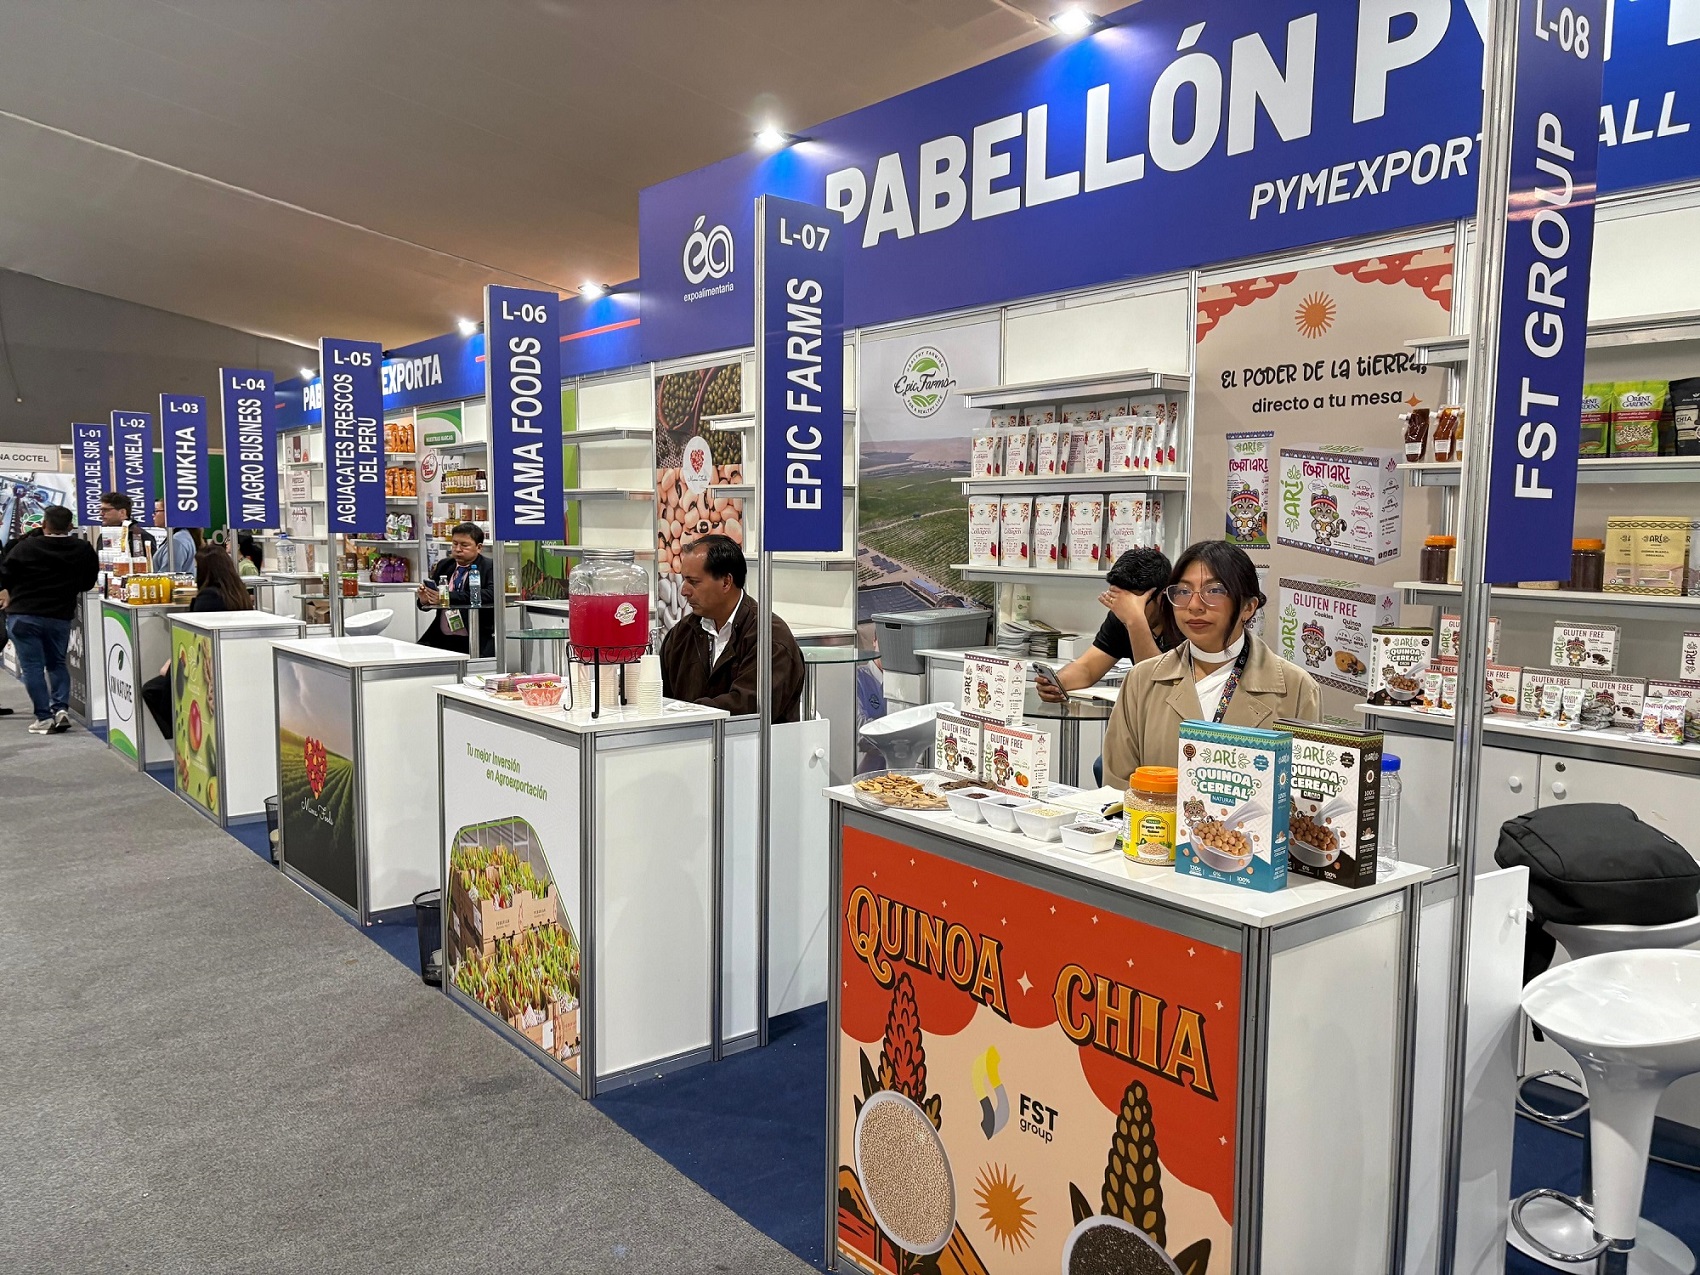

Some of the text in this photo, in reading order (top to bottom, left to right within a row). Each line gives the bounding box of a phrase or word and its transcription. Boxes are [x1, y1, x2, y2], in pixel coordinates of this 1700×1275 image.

[826, 12, 1317, 249] PABELLÓN
[1250, 134, 1482, 220] PYMEXPOR
[780, 217, 831, 252] L-07
[683, 282, 734, 303] expoalimentaria
[502, 300, 548, 324] L-06
[1514, 111, 1576, 500] FST GROUP
[334, 349, 372, 366] L-05
[232, 377, 266, 391] L-04
[1243, 363, 1298, 387] PODER
[1302, 360, 1326, 381] DE
[786, 278, 823, 510] EPIC FARMS
[1252, 390, 1403, 414] directo a tu mesa
[170, 401, 199, 414] L-03
[120, 417, 145, 428] L-02
[508, 336, 545, 525] MAMA FOODS
[79, 429, 101, 438] L-01
[12, 454, 49, 463] COCTEL
[332, 373, 357, 525] AGUACATES FRESCOS
[175, 426, 198, 512] SUMKHA
[237, 398, 266, 522] XM AGRO BUSINESS
[358, 456, 378, 483] DEL
[83, 441, 103, 522] AGRICOLA DEL SUR
[124, 433, 146, 523] AVENA Y CANELA
[1293, 592, 1358, 618] GLUTEN FREE
[1563, 628, 1605, 639] GLUTEN FREE
[1390, 648, 1420, 656] QUINOA
[1391, 655, 1419, 663] CEREAL
[1495, 671, 1510, 679] FREE
[1531, 675, 1555, 684] GLUTEN
[1591, 681, 1634, 692] GLUTEN FREE
[941, 721, 971, 737] GLUTEN FREE
[990, 732, 1009, 747] GLUTEN
[1010, 737, 1024, 750] FREE
[466, 742, 474, 758] Tu
[473, 748, 492, 764] mejor
[1212, 748, 1237, 769] ARÍ
[1302, 745, 1325, 765] ARÍ
[486, 767, 548, 801] en Agroexportación
[1195, 767, 1253, 788] QUINOA
[1290, 764, 1339, 785] QUINOA
[1198, 781, 1250, 801] CEREAL
[1290, 777, 1336, 796] CEREAL
[1303, 790, 1321, 800] CACAO
[1212, 794, 1236, 805] NATURAL
[1236, 875, 1251, 884] 100%
[845, 885, 1012, 1024] QUINOA
[1053, 963, 1219, 1102] CHIA
[1019, 1093, 1059, 1133] FST
[1019, 1116, 1054, 1145] group
